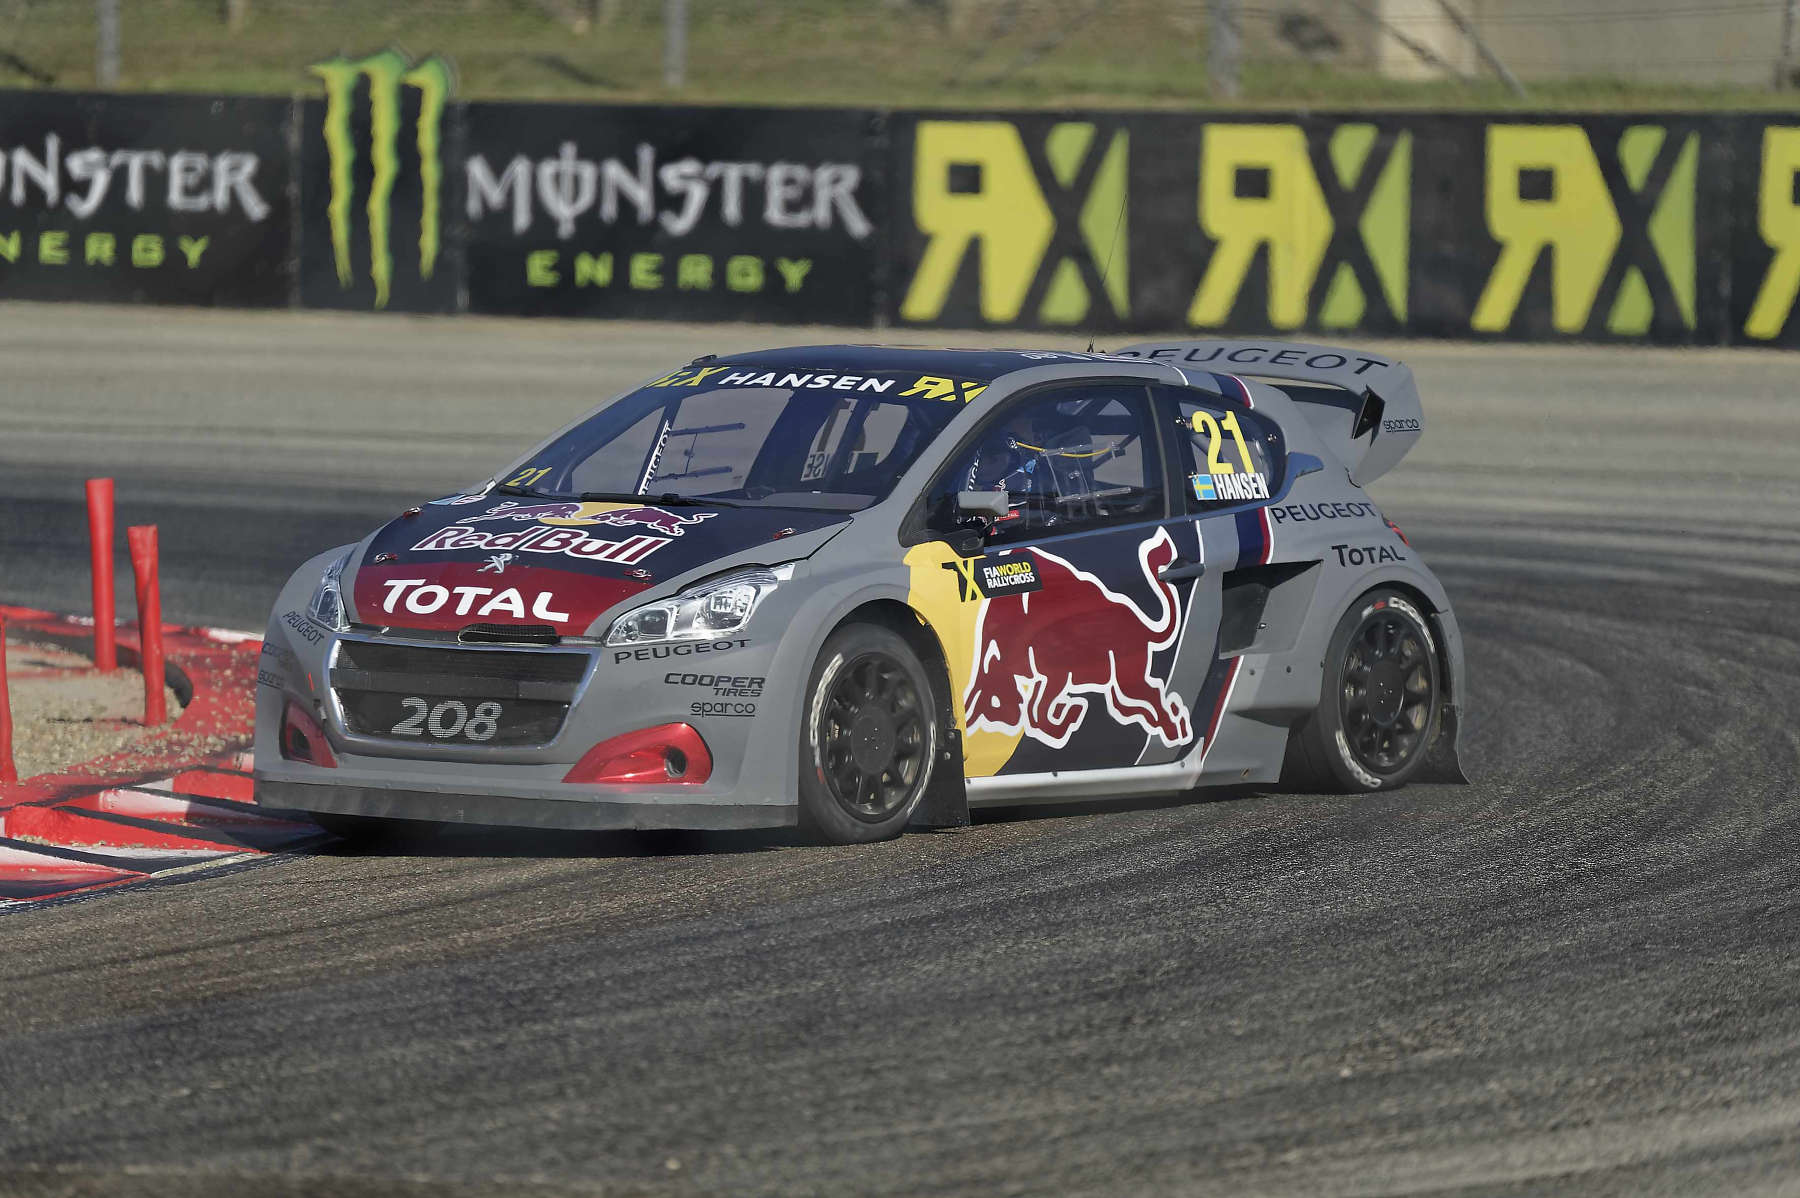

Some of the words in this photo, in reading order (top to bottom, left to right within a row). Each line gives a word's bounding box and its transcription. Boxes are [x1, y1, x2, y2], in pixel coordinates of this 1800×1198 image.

[0, 132, 271, 222] NSTER
[465, 140, 874, 240] MONSTER
[526, 249, 813, 293] ENERGY
[718, 372, 896, 393] HANSEN
[1383, 418, 1421, 432] sparco
[1192, 410, 1256, 474] 21
[505, 467, 552, 487] 21
[1213, 472, 1270, 500] HANSEN
[1271, 502, 1379, 525] PEUGEOT
[410, 526, 541, 552] Red
[530, 527, 675, 565] Bull
[1331, 544, 1407, 567] TOTAL
[986, 572, 1036, 589] RALLYCROSS
[382, 578, 569, 623] TOTAL
[282, 610, 324, 646] PEUGEOT
[614, 638, 750, 664] PEUGEOT
[664, 672, 766, 689] COOPER
[713, 687, 763, 697] TIRES
[391, 696, 503, 741] 208
[690, 702, 756, 717] sparco
